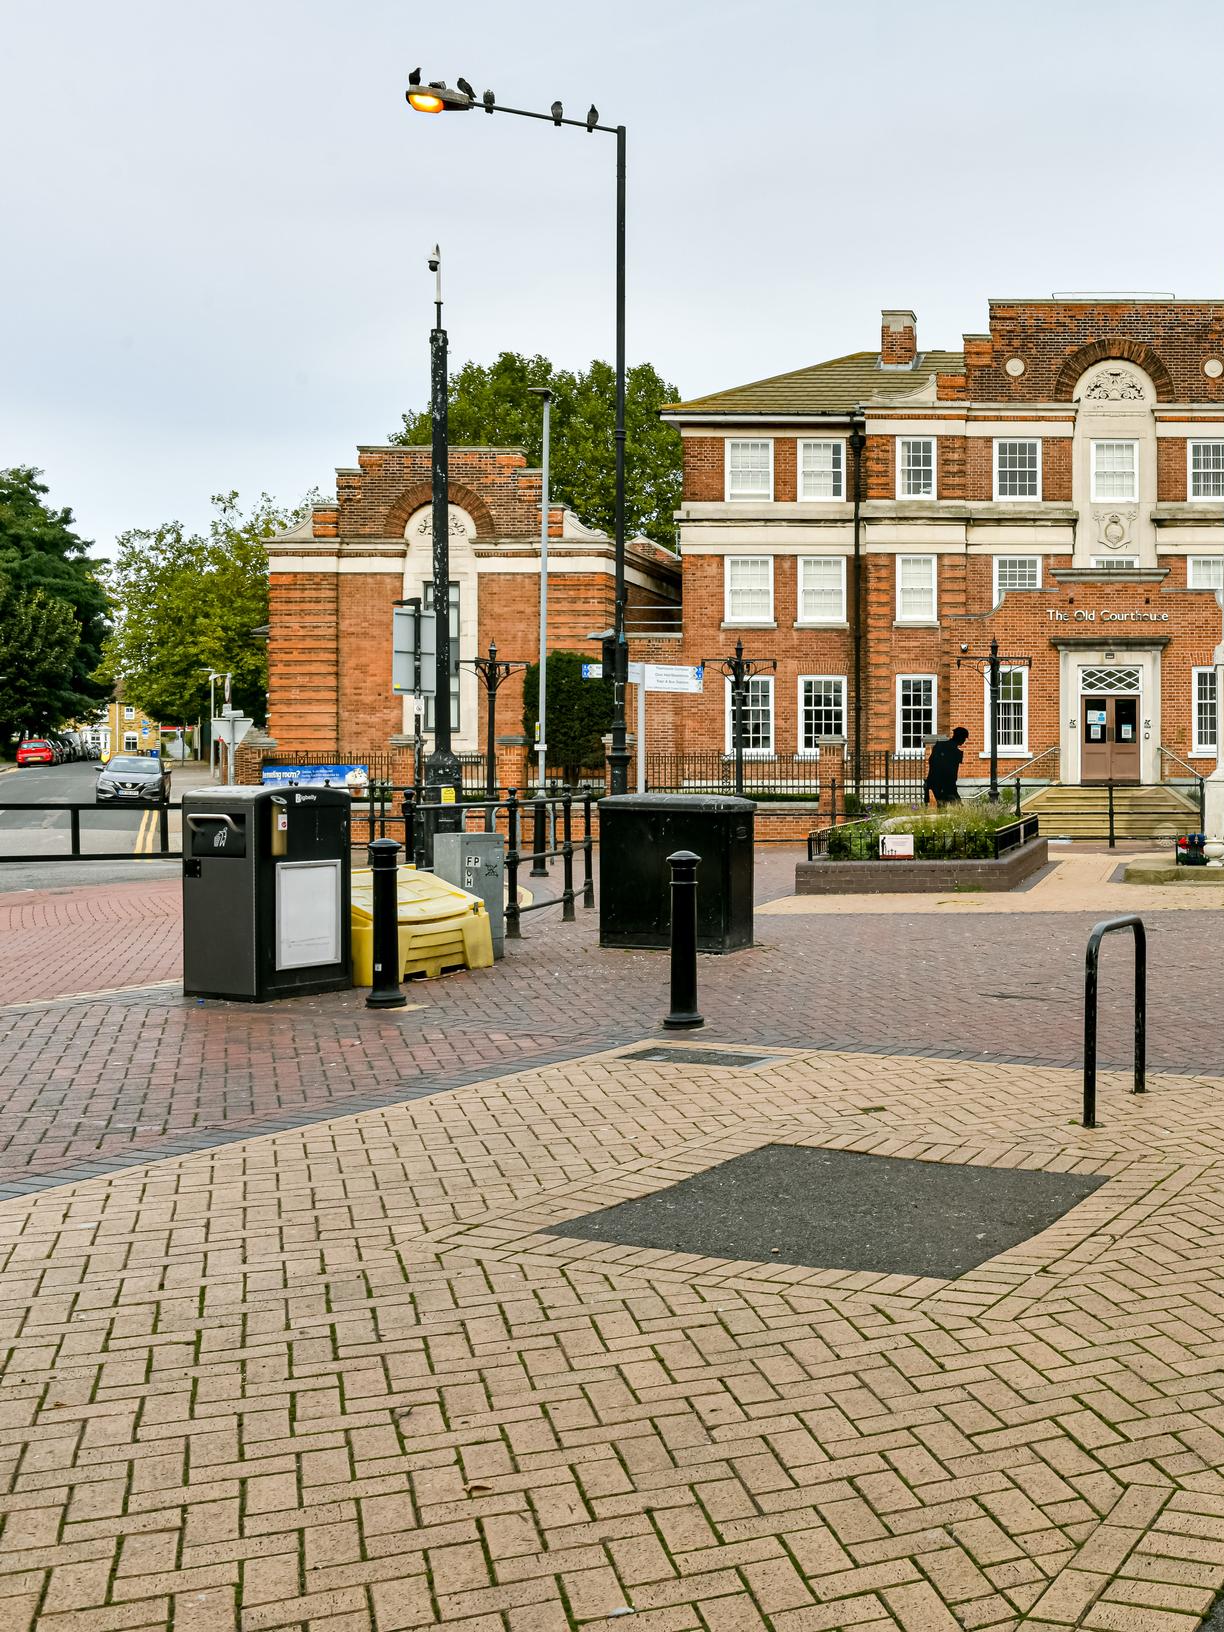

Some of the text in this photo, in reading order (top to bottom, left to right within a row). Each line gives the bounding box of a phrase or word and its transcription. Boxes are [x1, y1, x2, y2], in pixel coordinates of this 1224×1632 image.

[1046, 609, 1169, 621] The Old Courthouse
